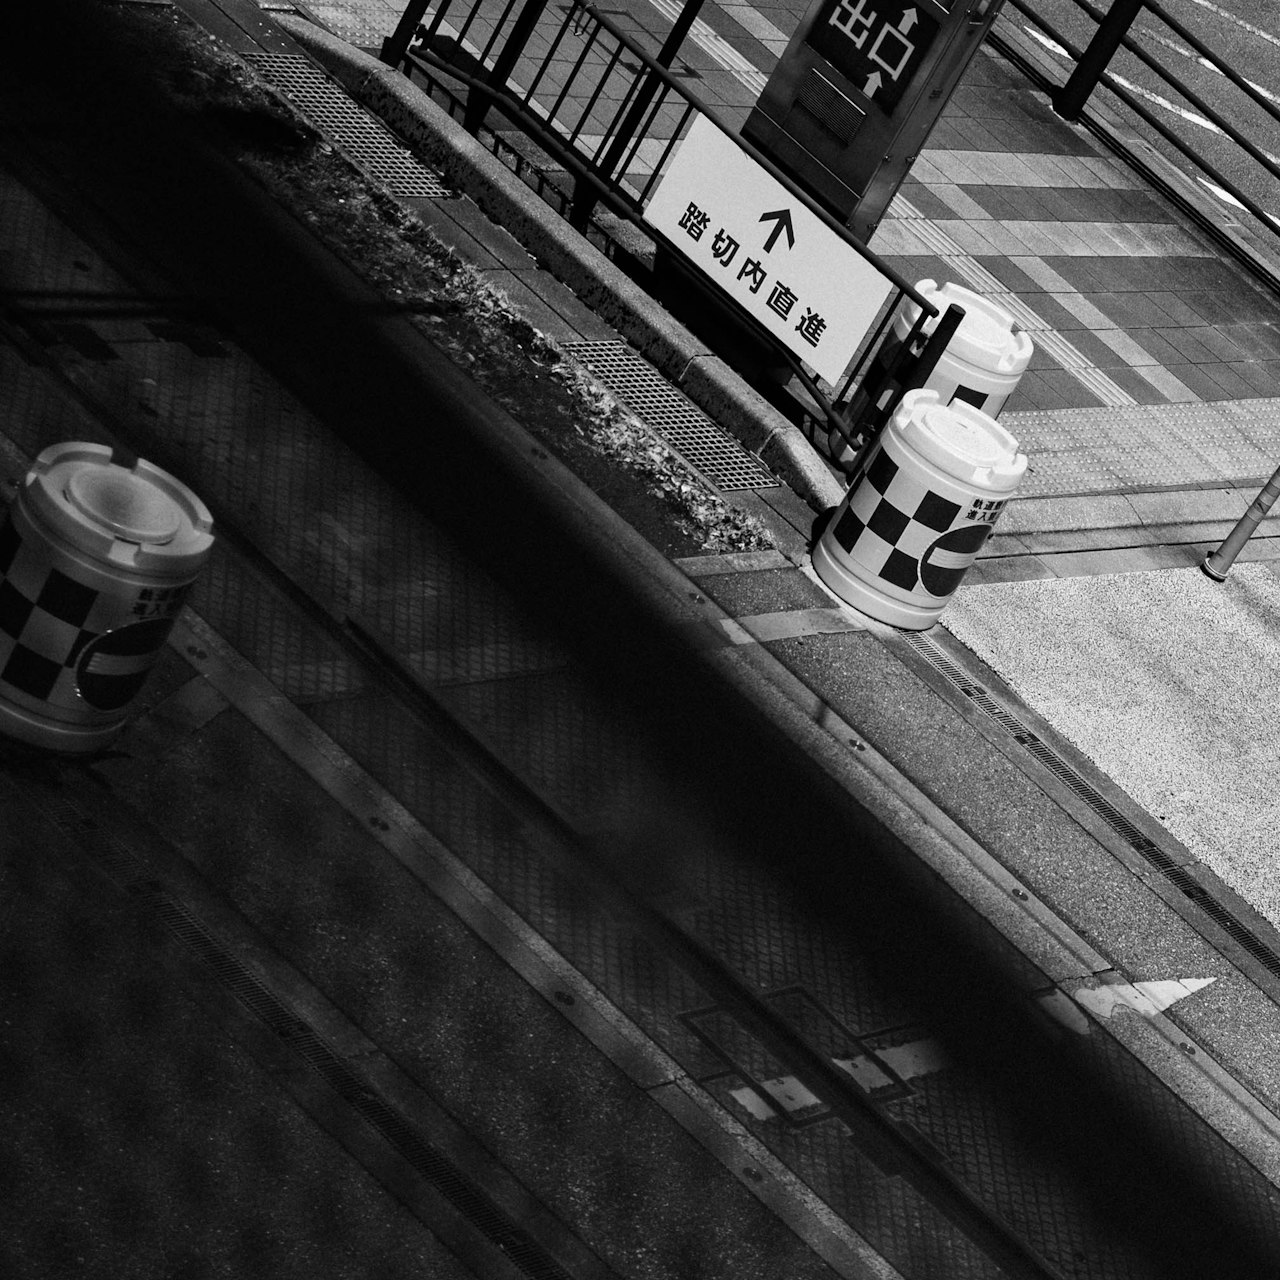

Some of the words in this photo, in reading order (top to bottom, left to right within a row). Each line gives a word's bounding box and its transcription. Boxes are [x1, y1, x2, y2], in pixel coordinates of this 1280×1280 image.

[828, 0, 915, 81] 出口
[677, 201, 829, 347] 踏切内直進
